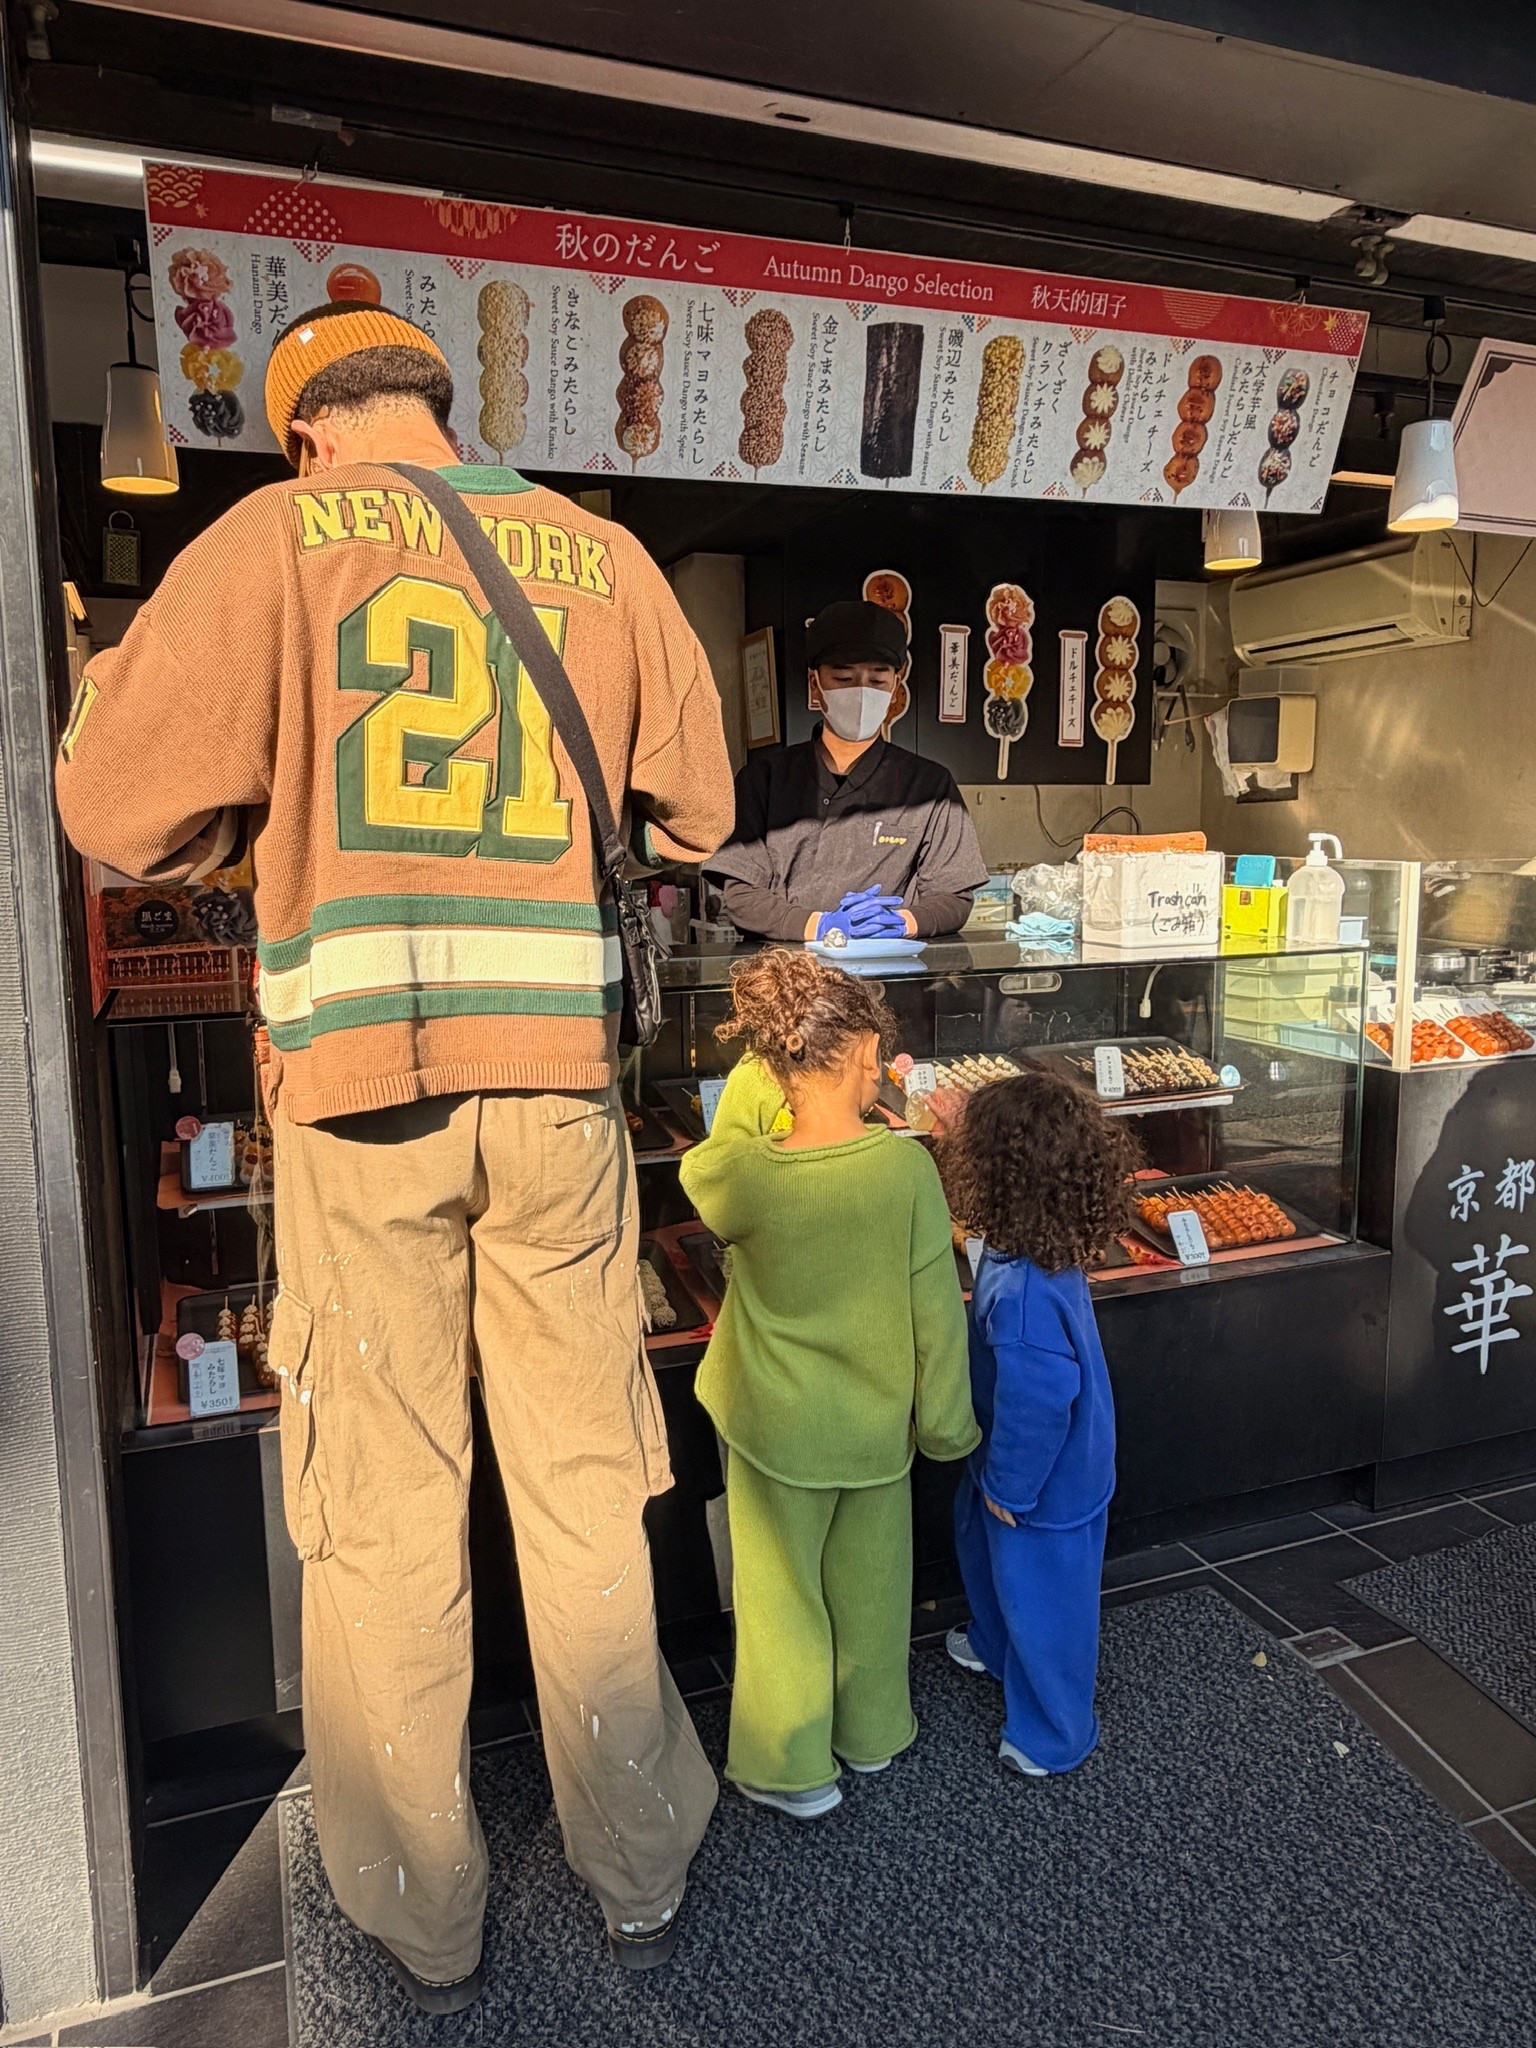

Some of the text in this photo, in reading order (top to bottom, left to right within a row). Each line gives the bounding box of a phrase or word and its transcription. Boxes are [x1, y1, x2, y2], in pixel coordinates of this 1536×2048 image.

[555, 222, 721, 275] 秋のだんご
[251, 254, 264, 335] Hanami Dango
[405, 269, 415, 300] Sweet
[763, 255, 994, 302] Autumn Dango Selection
[1031, 284, 1127, 319] 秋天的团子
[807, 343, 818, 359] Soy
[811, 312, 821, 341] Sweet
[937, 326, 947, 354] Sweet
[1029, 336, 1039, 362] Sweet
[547, 284, 561, 460] Sweet Soy Sauce Dango with Kinako
[563, 287, 581, 436] きなこみたらし
[676, 299, 695, 459] Sweet Soy Sauce Dango with Spice
[692, 302, 715, 465] 七味マヨみたらし
[806, 362, 816, 388] Sauce
[815, 315, 839, 453] 金ごまみたらし
[933, 355, 944, 372] Soy
[1025, 363, 1036, 380] Soy
[1051, 340, 1073, 414] ざくざく
[1136, 347, 1147, 372] Sweet
[803, 391, 813, 421] Dango
[931, 374, 941, 399] Sauce
[939, 328, 964, 442] 磯辺みたらし
[1023, 381, 1034, 407] Sauce
[1137, 351, 1157, 421] みたらし
[1243, 361, 1269, 430] 大学芋風
[801, 422, 811, 441] with
[926, 401, 938, 431] Dango
[1016, 409, 1029, 438] Dango
[1022, 340, 1053, 485] クランチみたらし
[1220, 362, 1253, 479] みたらしだんご
[1308, 370, 1340, 468] チョコだんご
[924, 431, 934, 450] with
[294, 489, 442, 557] NEW
[948, 641, 961, 708] 華美だんご
[1067, 647, 1078, 728] ドルチェチーズ
[338, 574, 572, 863] 21
[1148, 891, 1207, 908] Trash can
[1447, 1157, 1536, 1222] 京都
[1443, 1233, 1534, 1376] 華
[207, 1363, 217, 1395] みたらし
